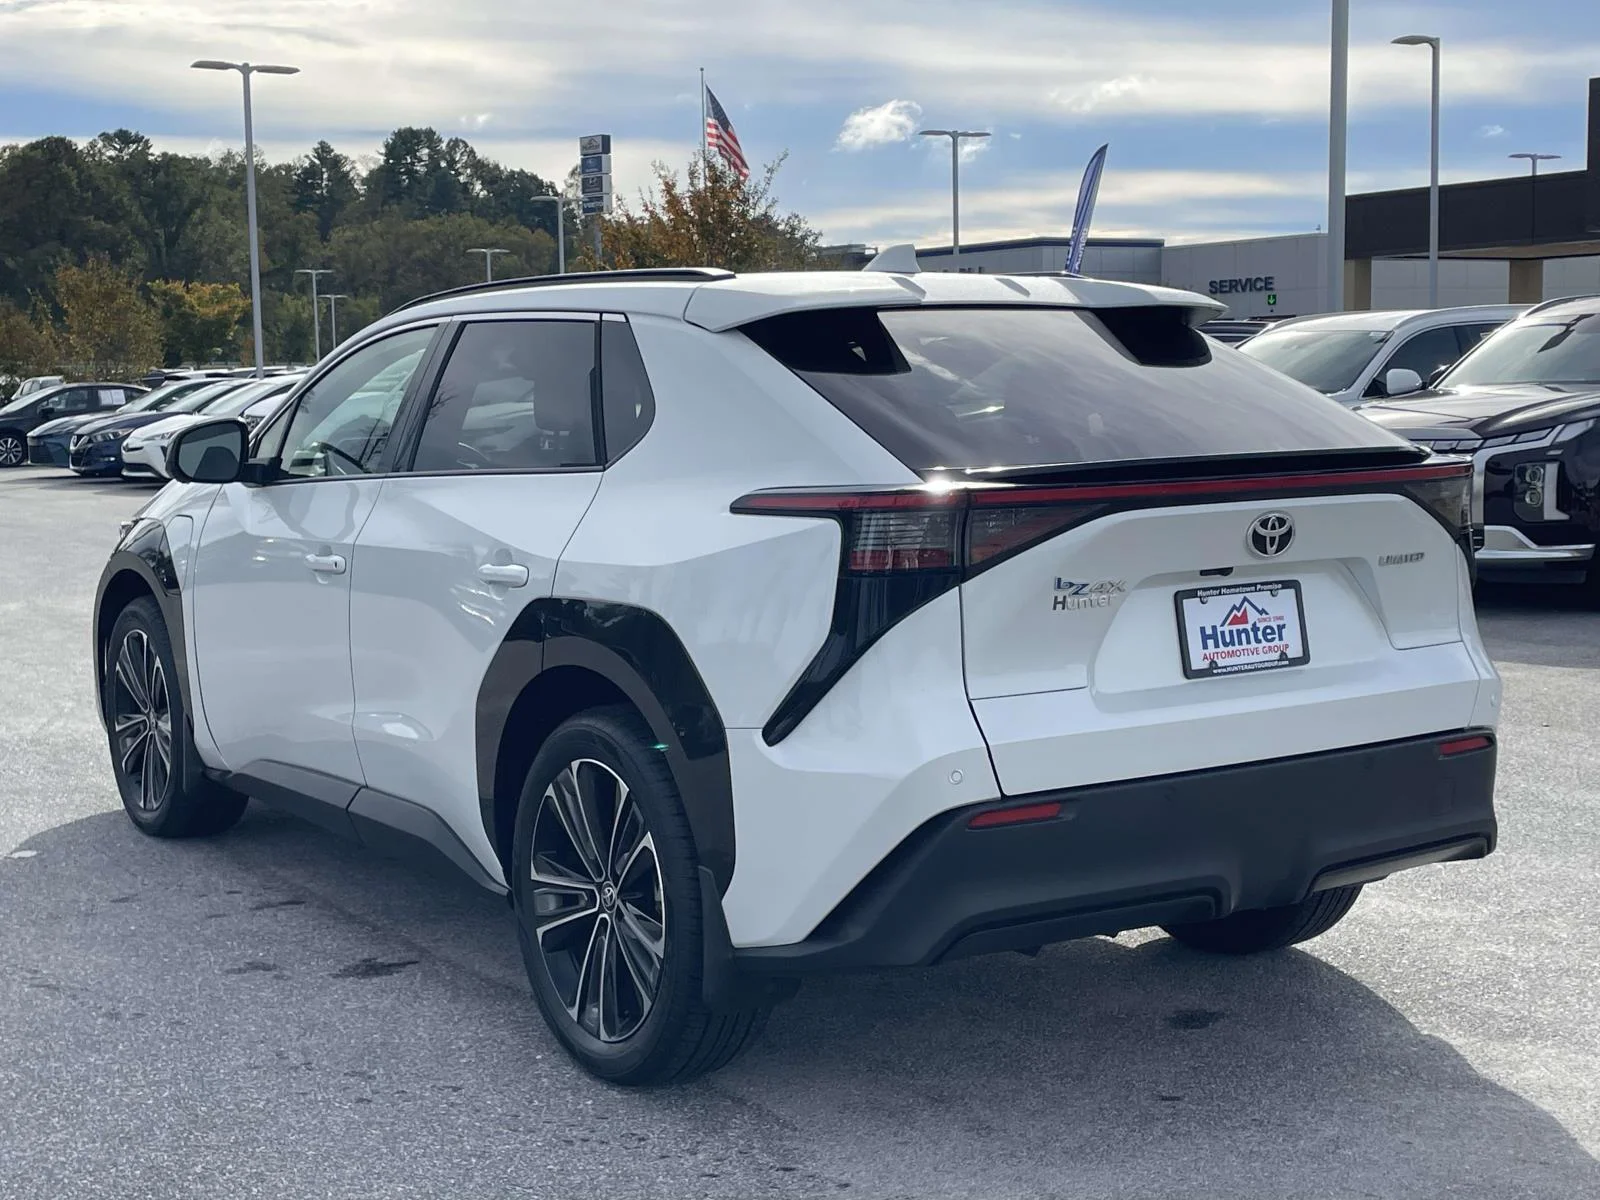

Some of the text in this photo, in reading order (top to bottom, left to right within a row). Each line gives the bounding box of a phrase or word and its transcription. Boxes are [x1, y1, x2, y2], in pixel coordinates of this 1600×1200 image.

[1208, 276, 1274, 294] SERVICE
[1197, 583, 1282, 597] Hunter Hometown Promise
[1052, 594, 1114, 611] Hunter
[1200, 621, 1286, 650] Hunter
[1203, 644, 1289, 661] AUTOMOTIVE GROUP
